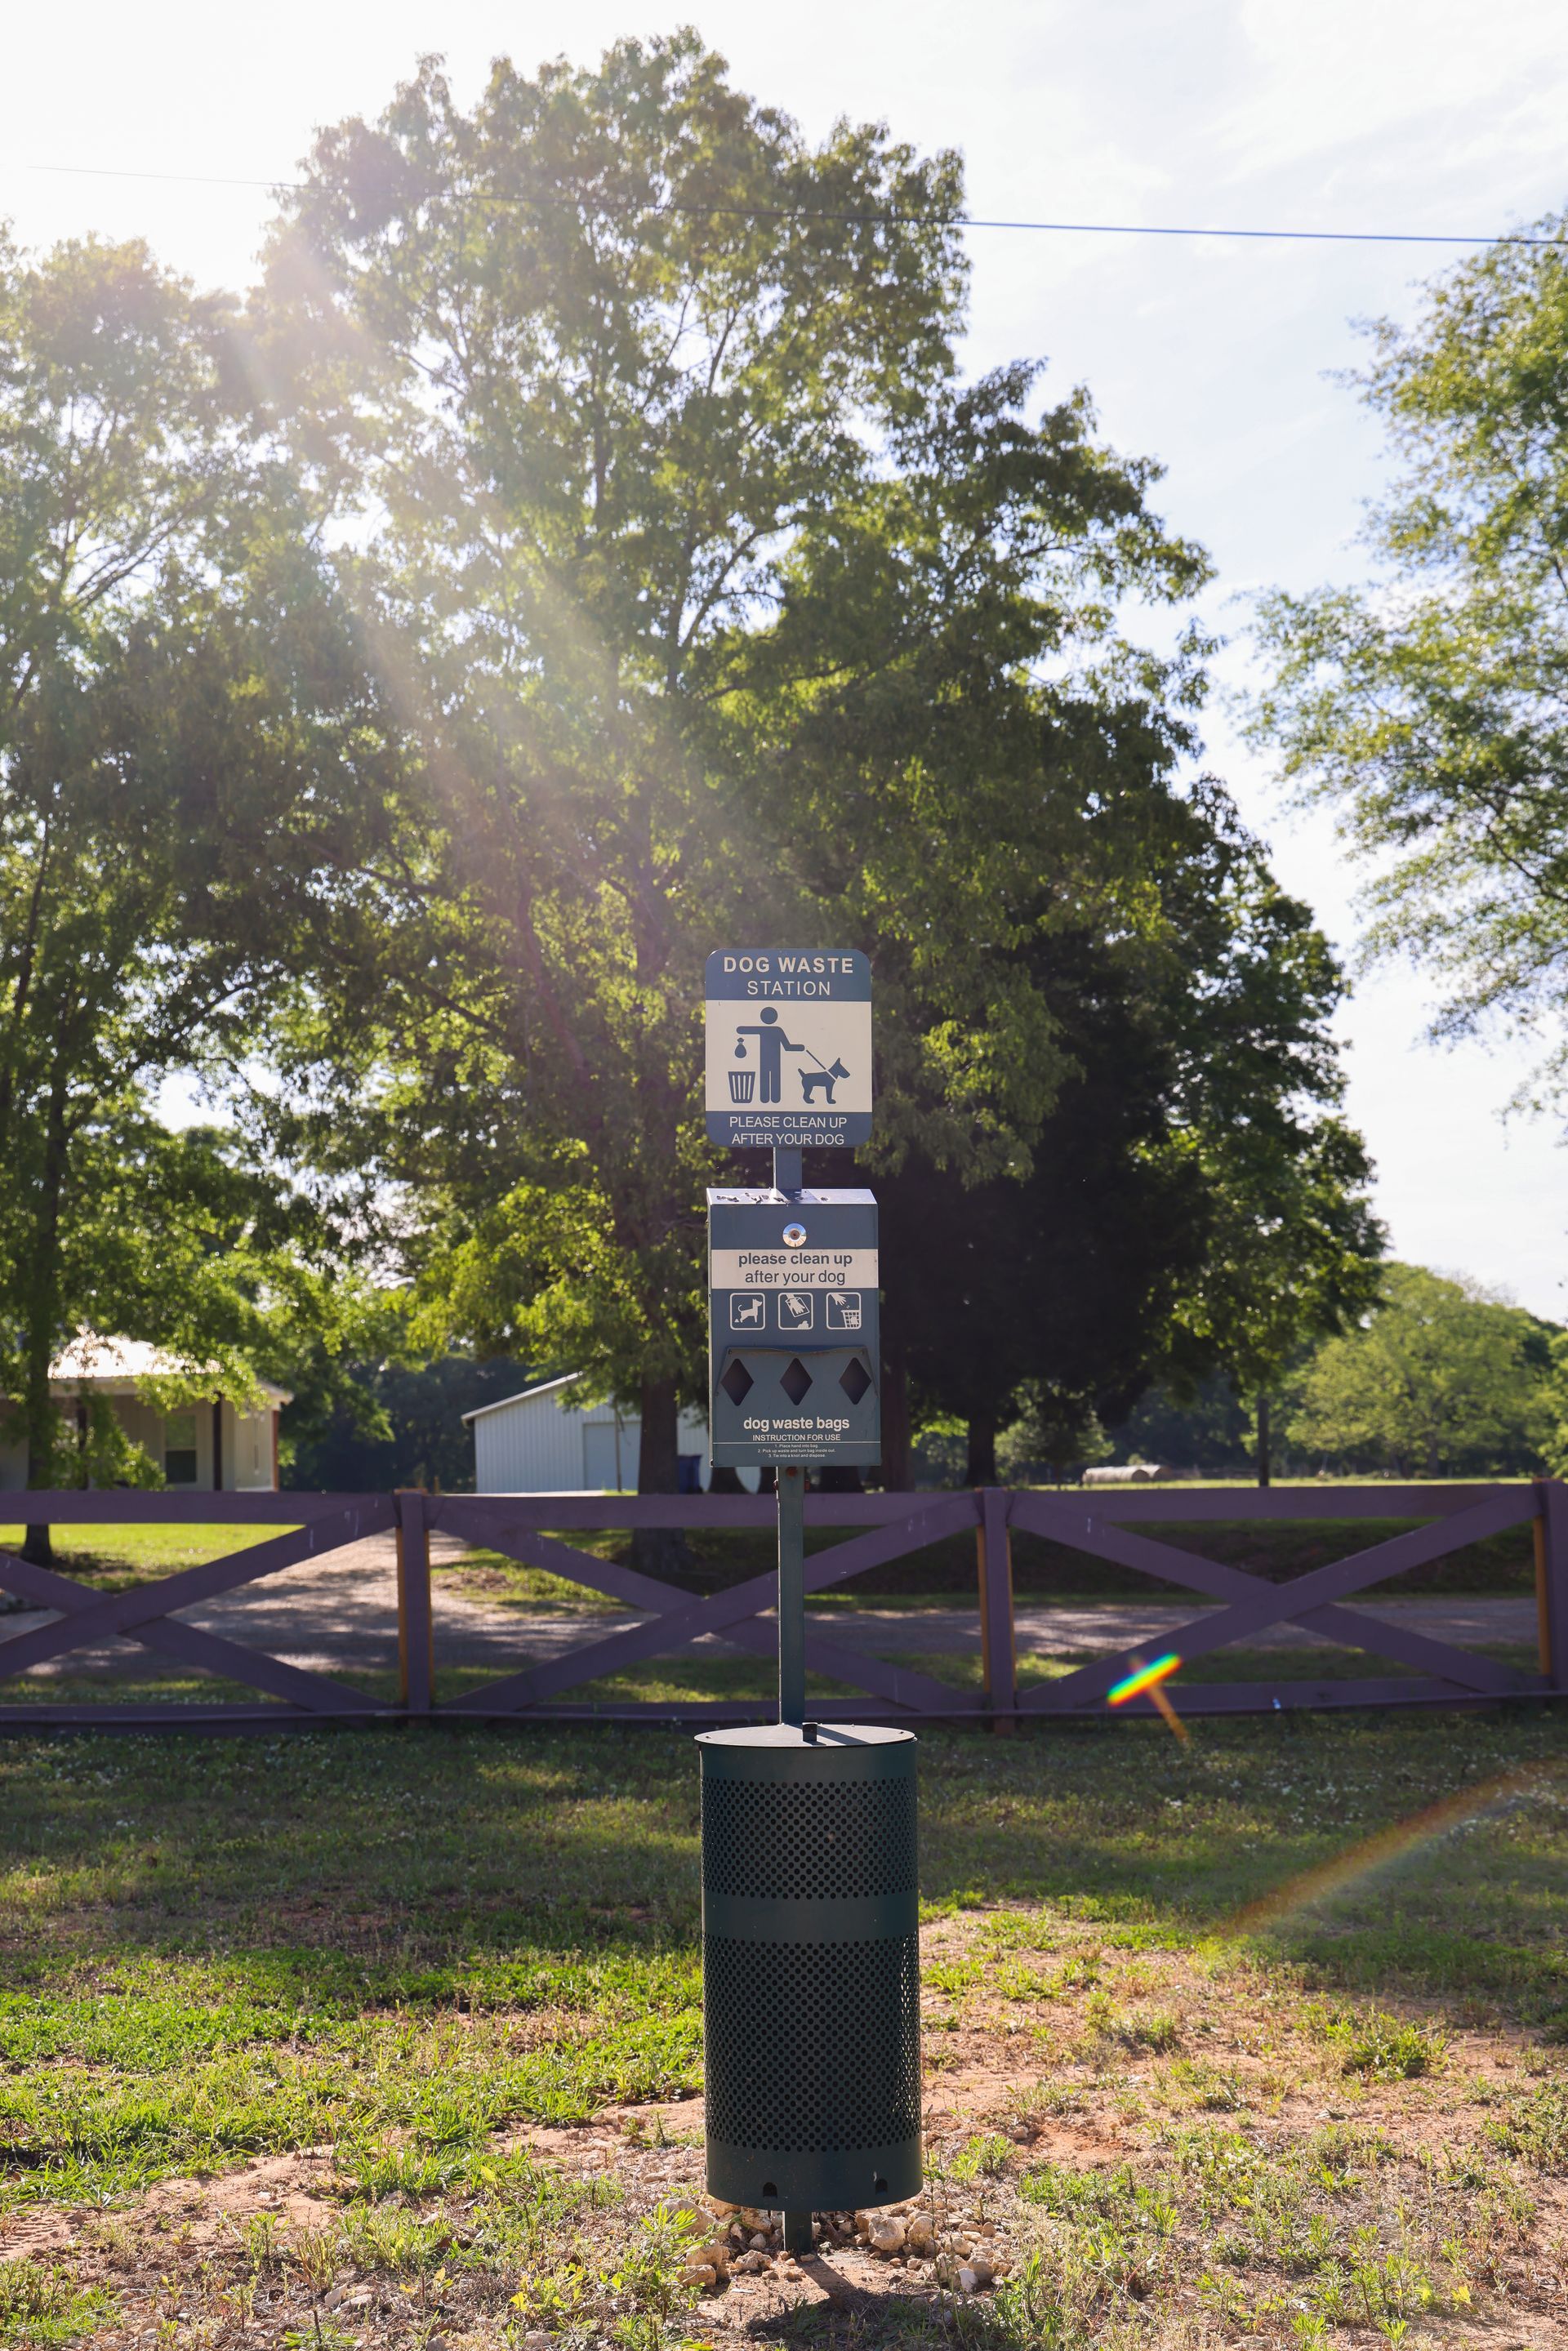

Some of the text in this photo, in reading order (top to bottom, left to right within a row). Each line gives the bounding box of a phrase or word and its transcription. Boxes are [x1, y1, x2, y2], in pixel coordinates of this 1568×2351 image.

[724, 956, 853, 973] DOG WASTE
[747, 980, 831, 995] STATION
[729, 1116, 847, 1129] PLEASE CLEAN UP
[732, 1133, 844, 1145] AFTER YOUR DOG
[738, 1253, 853, 1267] please clean up
[745, 1270, 845, 1285] after your dog
[743, 1417, 850, 1432] dog waste bags
